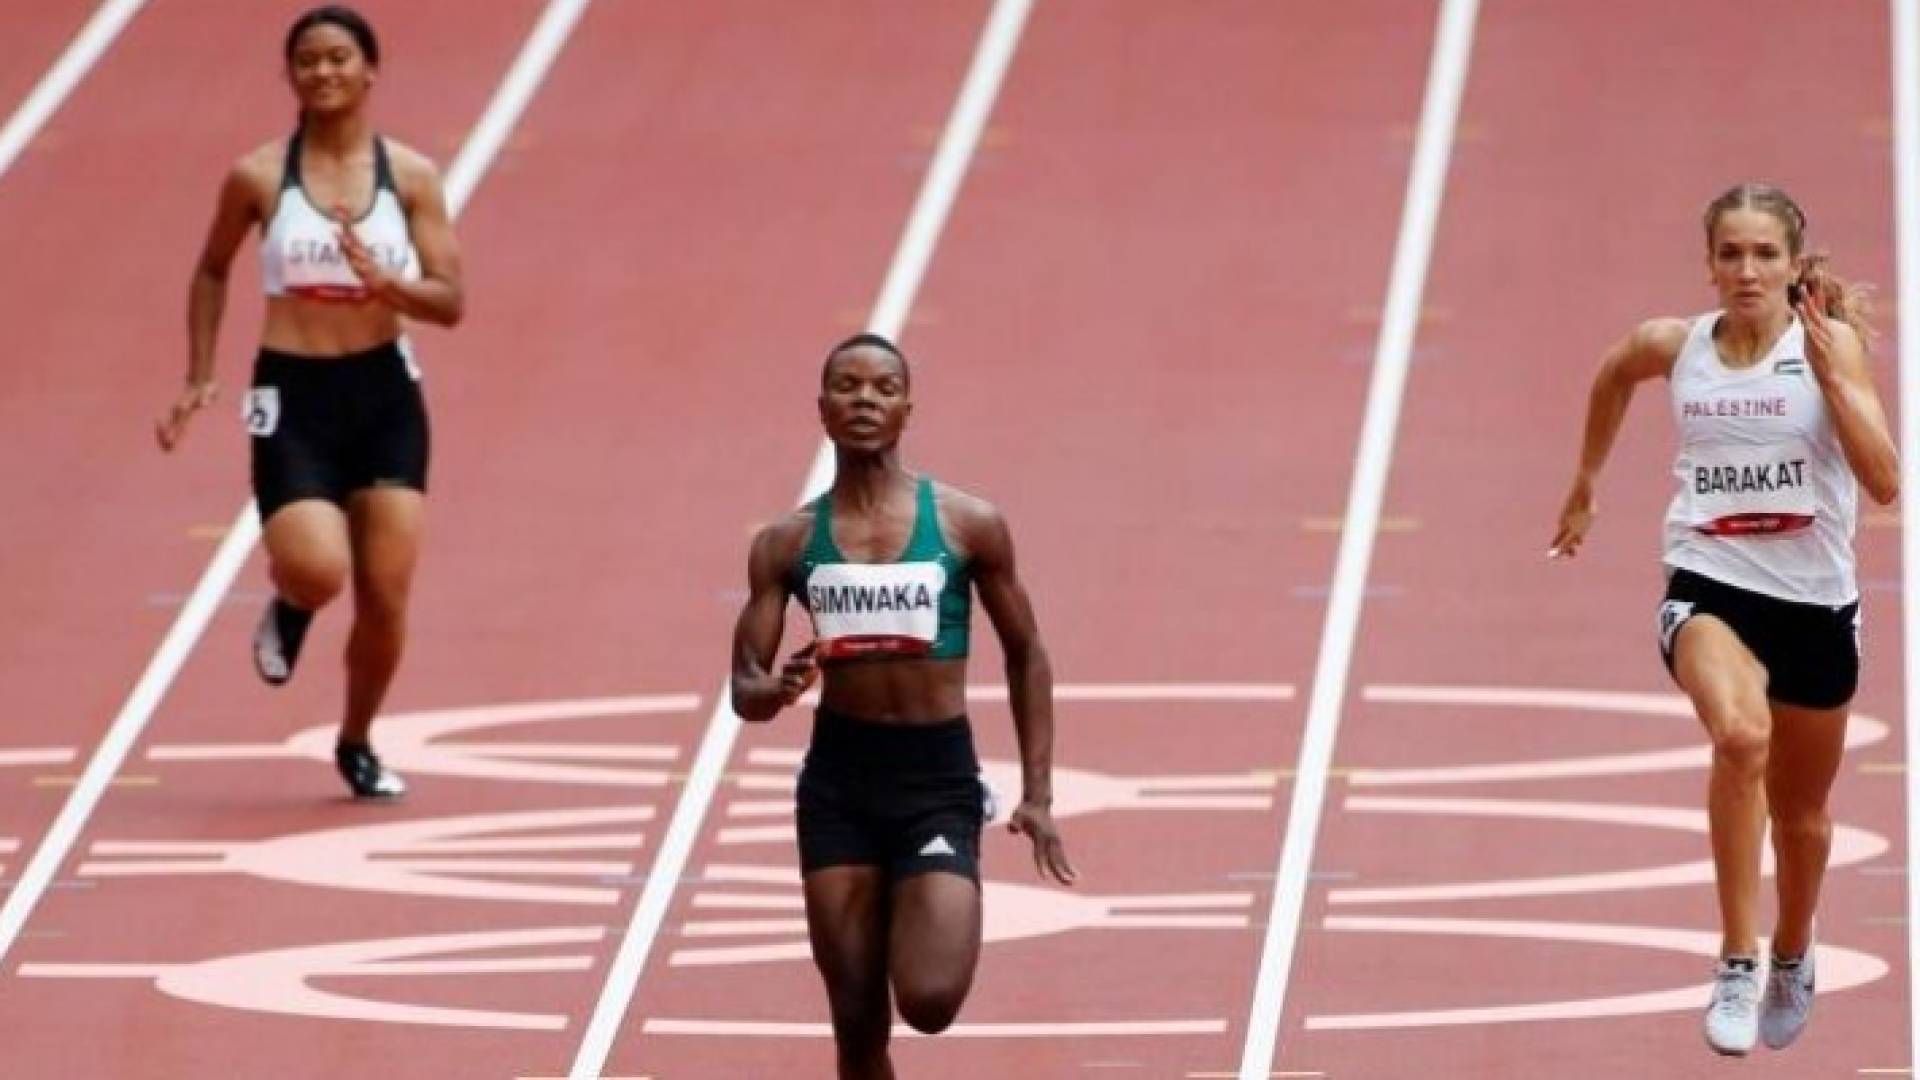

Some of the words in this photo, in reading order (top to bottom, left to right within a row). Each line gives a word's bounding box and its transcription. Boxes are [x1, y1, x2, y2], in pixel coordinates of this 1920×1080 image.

[1683, 397, 1787, 417] PALESTINE
[1695, 459, 1805, 494] BARAKAT
[811, 583, 932, 613] SIMWAKA
